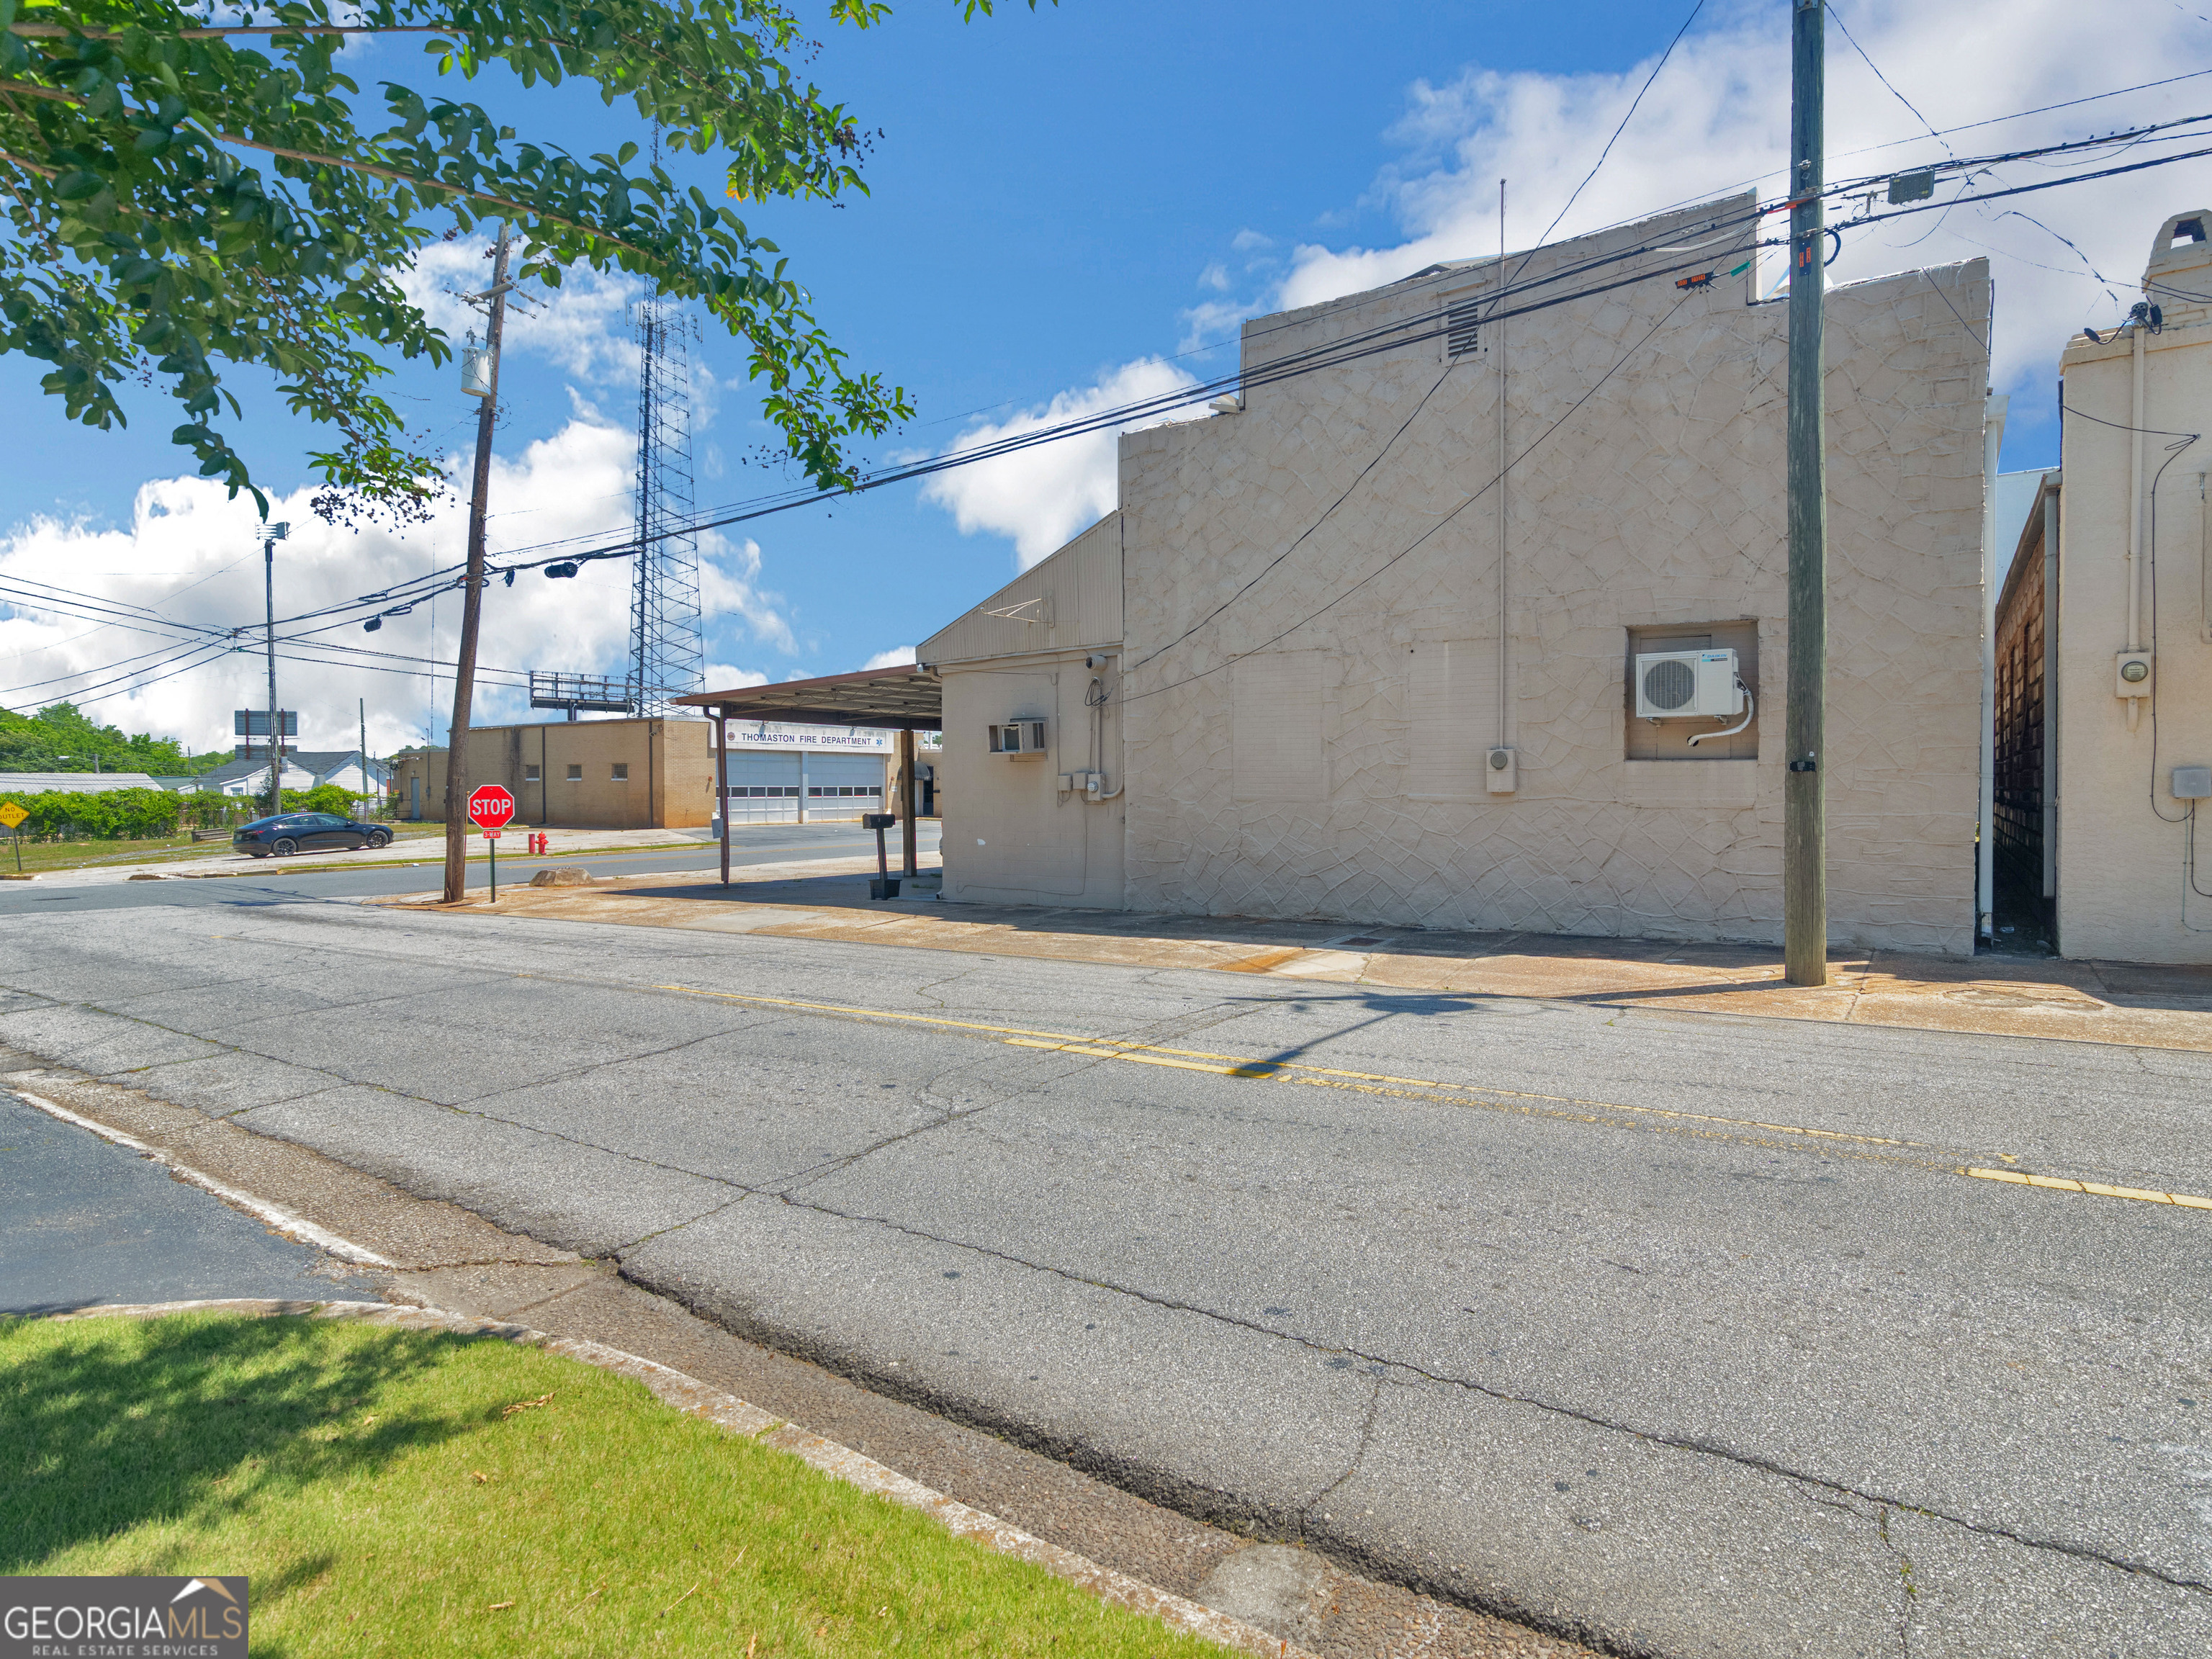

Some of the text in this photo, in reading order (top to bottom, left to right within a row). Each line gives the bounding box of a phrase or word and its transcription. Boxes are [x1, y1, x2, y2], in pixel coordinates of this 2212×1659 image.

[742, 733, 795, 742] THOMASTON
[822, 736, 871, 745] DEPARTMENT
[472, 799, 511, 815] STOP
